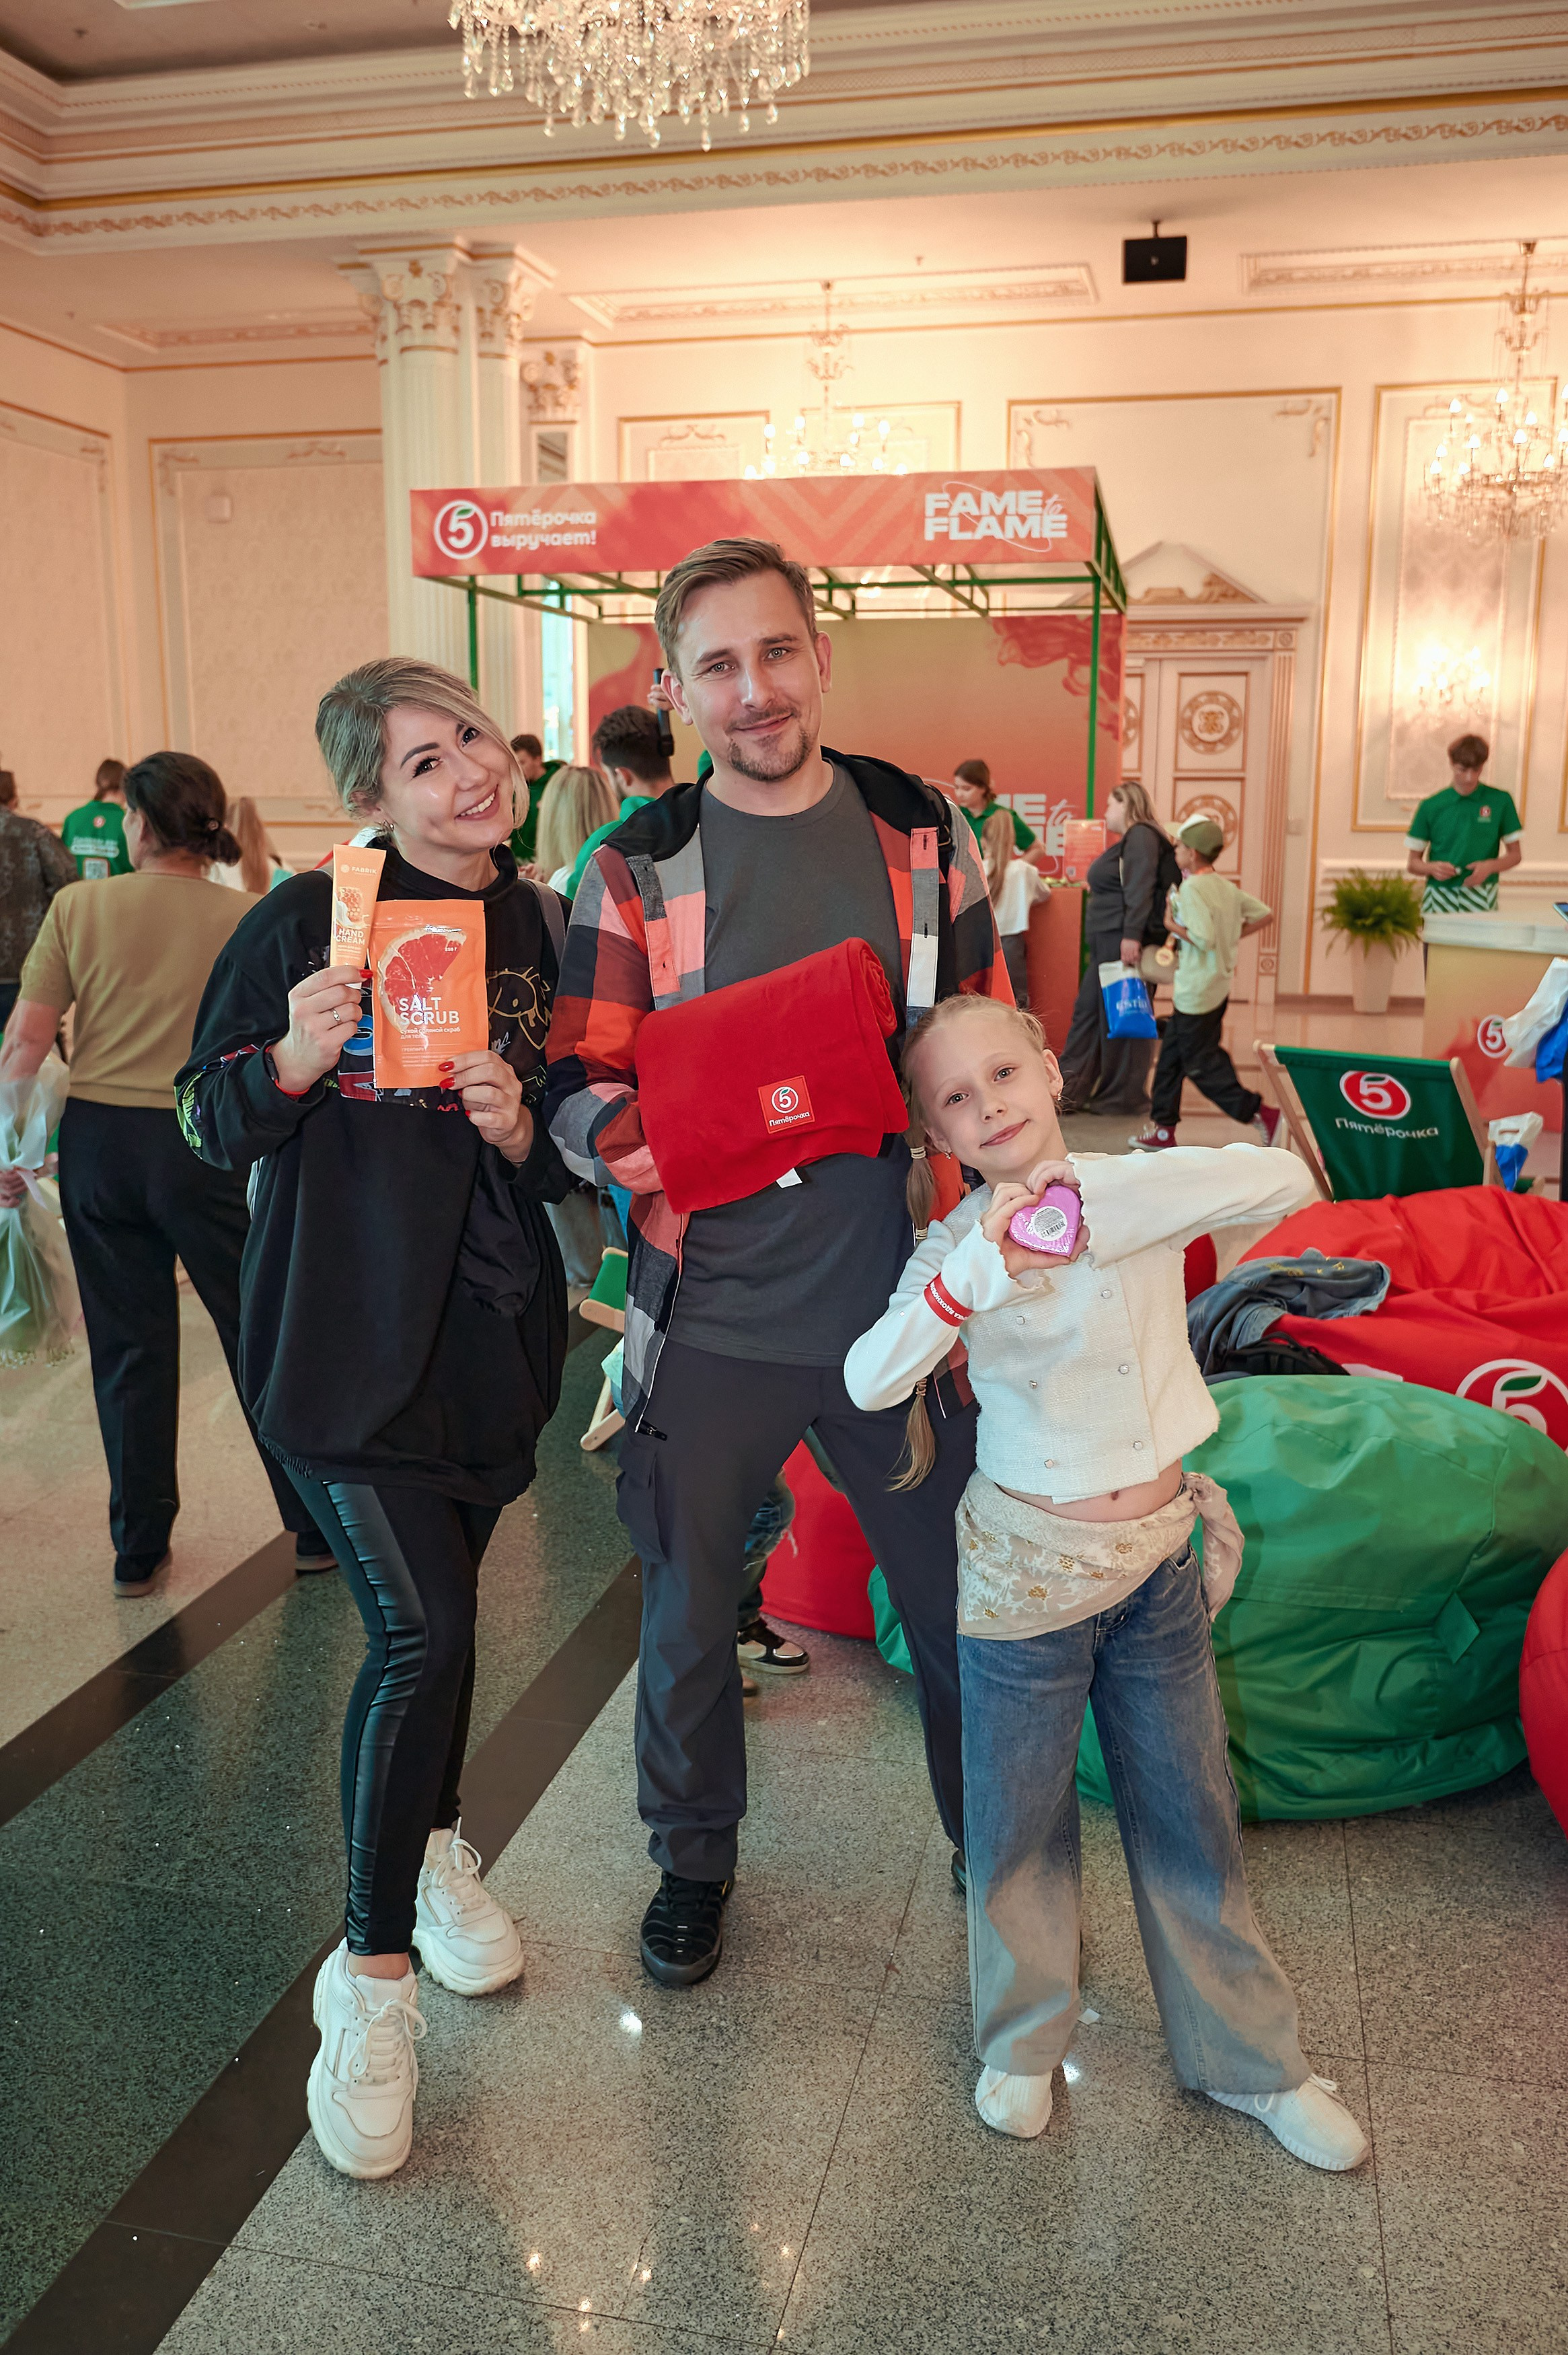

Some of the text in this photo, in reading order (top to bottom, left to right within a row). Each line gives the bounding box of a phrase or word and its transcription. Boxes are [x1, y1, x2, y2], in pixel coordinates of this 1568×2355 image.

[926, 490, 1066, 517] FAME to
[490, 509, 597, 530] Пятёрочка
[924, 514, 1068, 541] FLAME
[490, 530, 597, 551] выручает!
[336, 935, 365, 945] CREAM
[338, 929, 364, 938] HAND
[399, 996, 441, 1011] SALT
[400, 1011, 459, 1025] SCRUB
[770, 1112, 810, 1126] Пятёрочка
[1335, 1118, 1439, 1138] Пятёрочка
